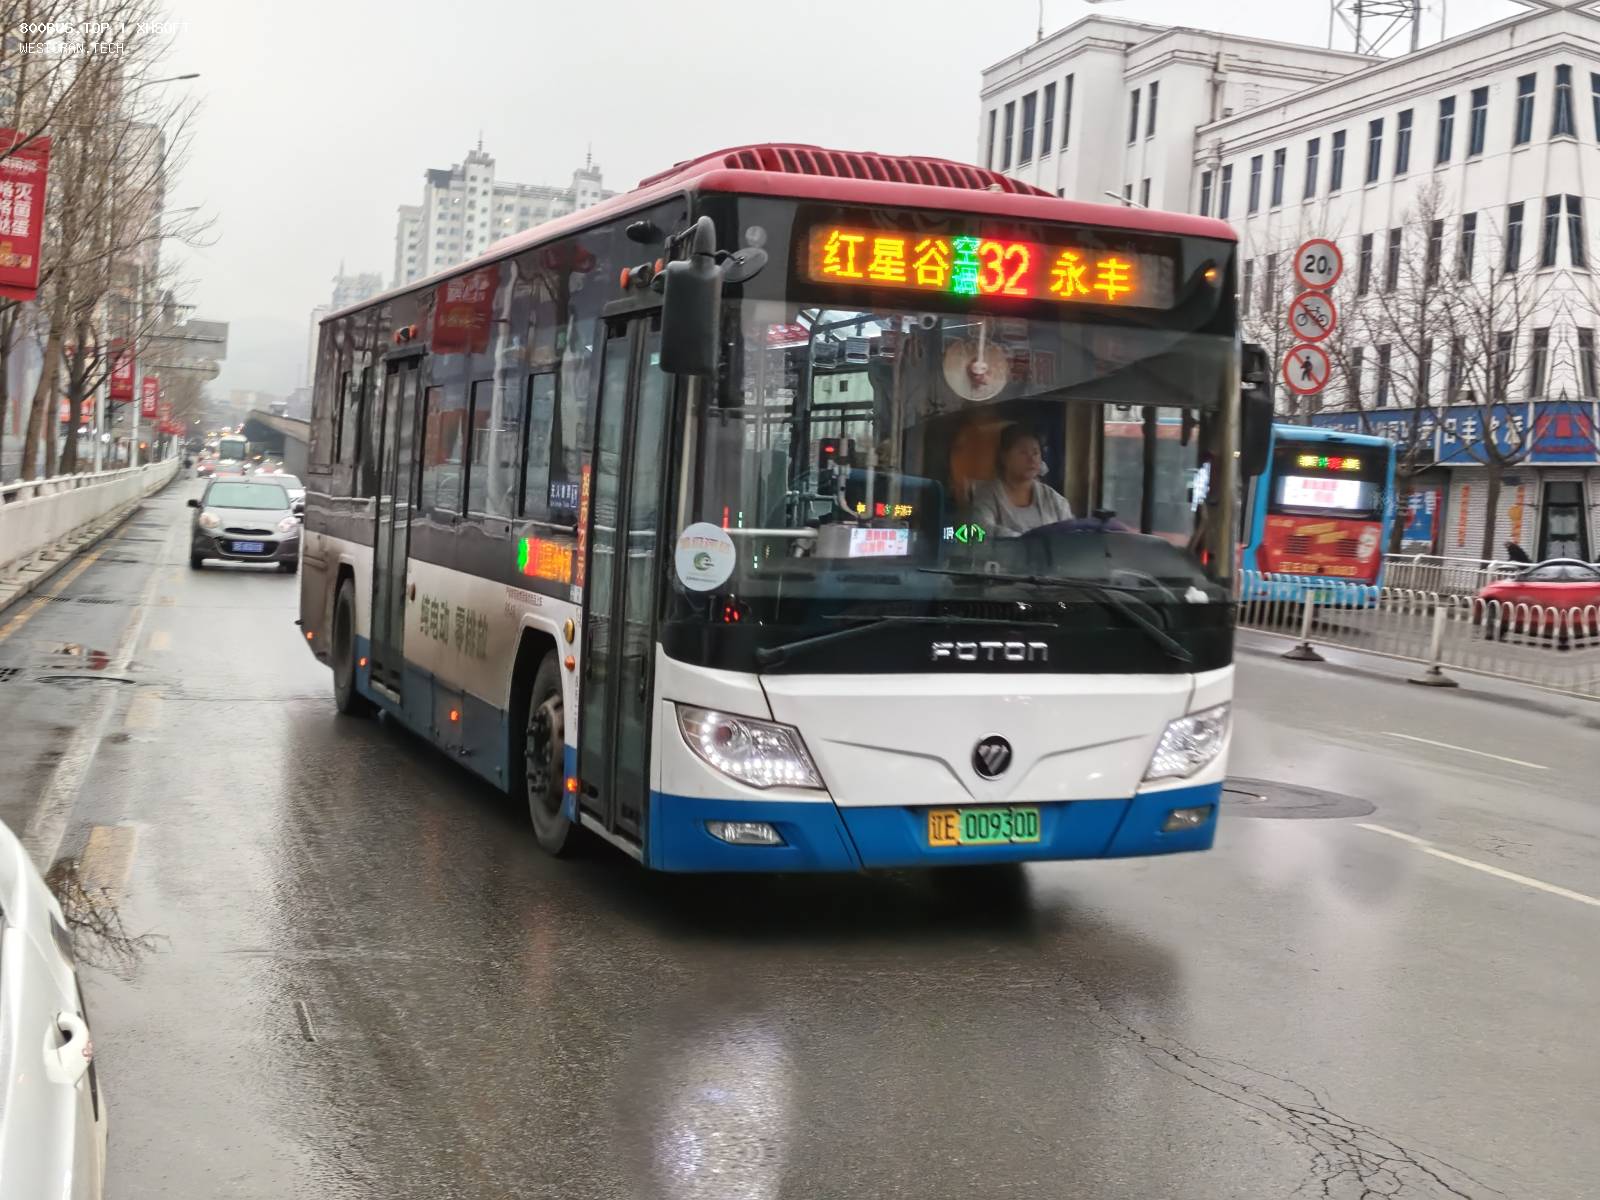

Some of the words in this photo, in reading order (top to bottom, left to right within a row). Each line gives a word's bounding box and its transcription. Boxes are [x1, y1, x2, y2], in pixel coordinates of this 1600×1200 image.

[823, 230, 949, 288] 红星谷
[953, 236, 980, 295] 空调
[979, 241, 1030, 296] 32
[1049, 252, 1131, 300] 永丰
[1304, 255, 1328, 274] 20
[931, 641, 1049, 662] FOTON
